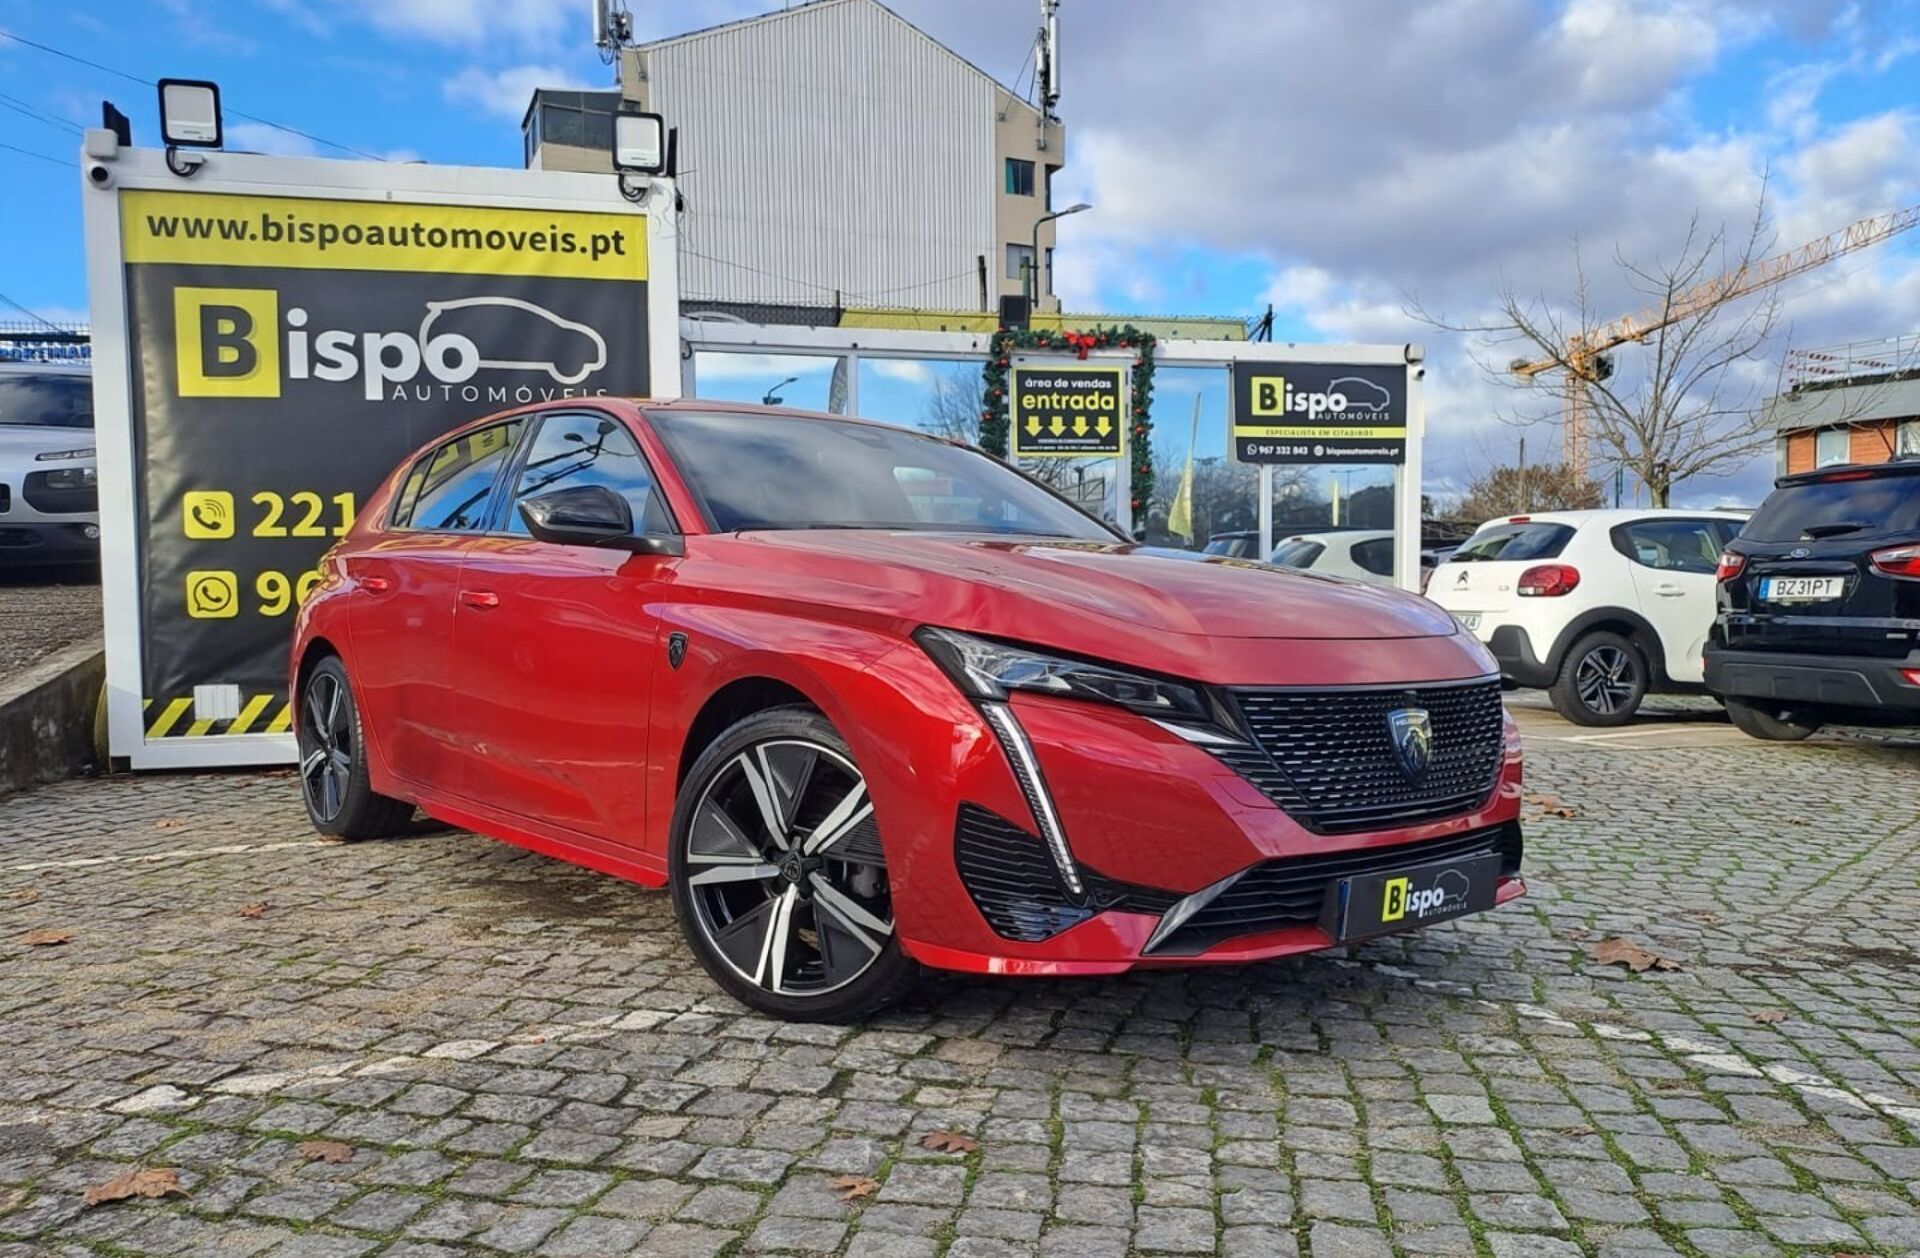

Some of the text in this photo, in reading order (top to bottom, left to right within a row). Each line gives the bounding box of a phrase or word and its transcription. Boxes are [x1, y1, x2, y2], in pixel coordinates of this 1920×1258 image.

[147, 213, 626, 261] www.bispoautomoveis.pt
[199, 304, 480, 399] Bispo
[1022, 391, 1114, 410] entrada
[1025, 377, 1112, 389] área de vendas
[1259, 383, 1348, 420] Bispo
[252, 491, 355, 537] 221
[1387, 882, 1445, 918] Bispo
